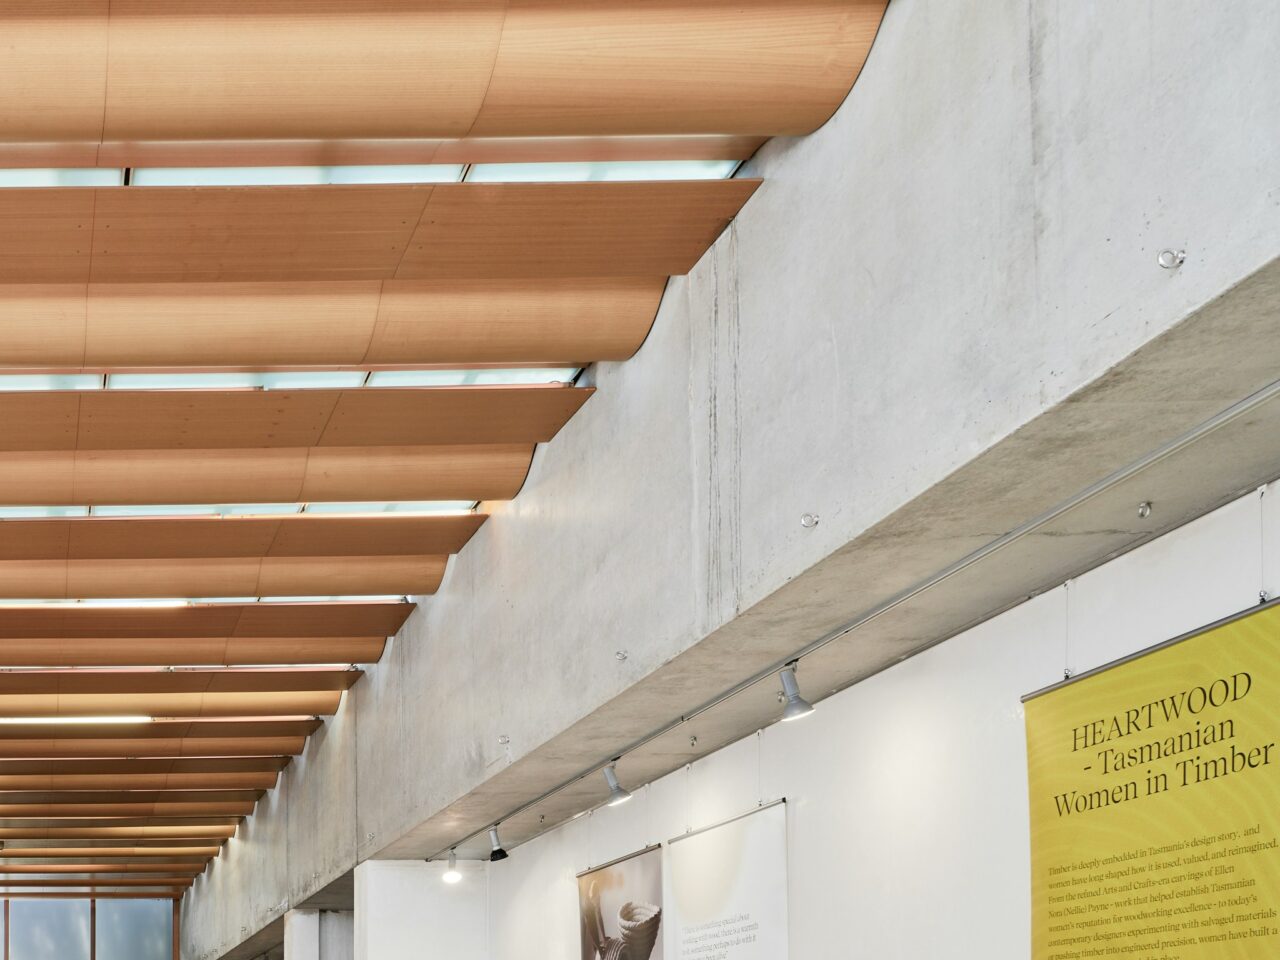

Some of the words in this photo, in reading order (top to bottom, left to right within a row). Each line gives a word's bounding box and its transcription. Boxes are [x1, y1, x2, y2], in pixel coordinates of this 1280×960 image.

[1072, 672, 1251, 752] HEARTWOOD
[1097, 719, 1235, 775] Tasmanian
[1054, 780, 1138, 817] Women
[1146, 769, 1168, 795] in
[1175, 743, 1274, 787] Timber
[1191, 835, 1216, 846] design
[1244, 824, 1260, 836] and
[1212, 848, 1226, 859] and
[1205, 866, 1214, 876] of
[1215, 864, 1234, 875] Ellen
[1211, 877, 1256, 892] Tasmanian
[1228, 893, 1257, 906] today's
[1201, 913, 1234, 927] salvaged
[1236, 908, 1277, 922] materials
[1199, 934, 1226, 943] women
[1229, 930, 1248, 940] have
[1249, 926, 1269, 937] built
